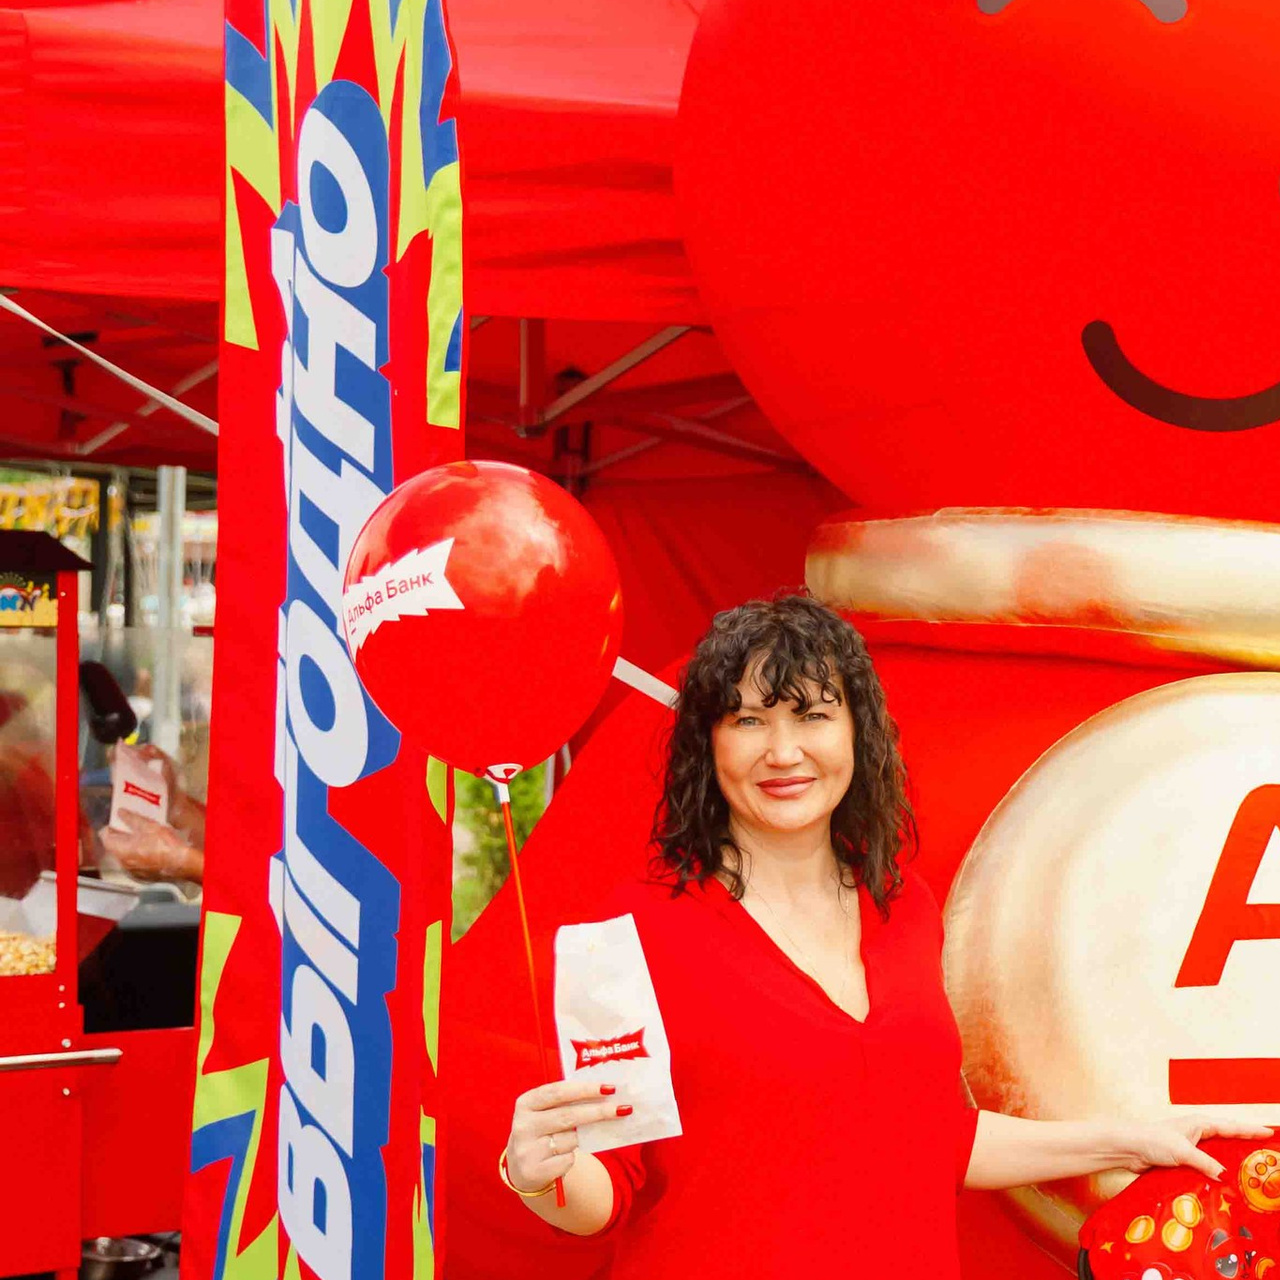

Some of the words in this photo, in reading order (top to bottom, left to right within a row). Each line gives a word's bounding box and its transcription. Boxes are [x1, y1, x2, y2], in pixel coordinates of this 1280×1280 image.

[348, 590, 384, 631] Альфа
[385, 571, 435, 600] Банк
[581, 1044, 614, 1061] Альфа
[613, 1041, 640, 1054] Банк
